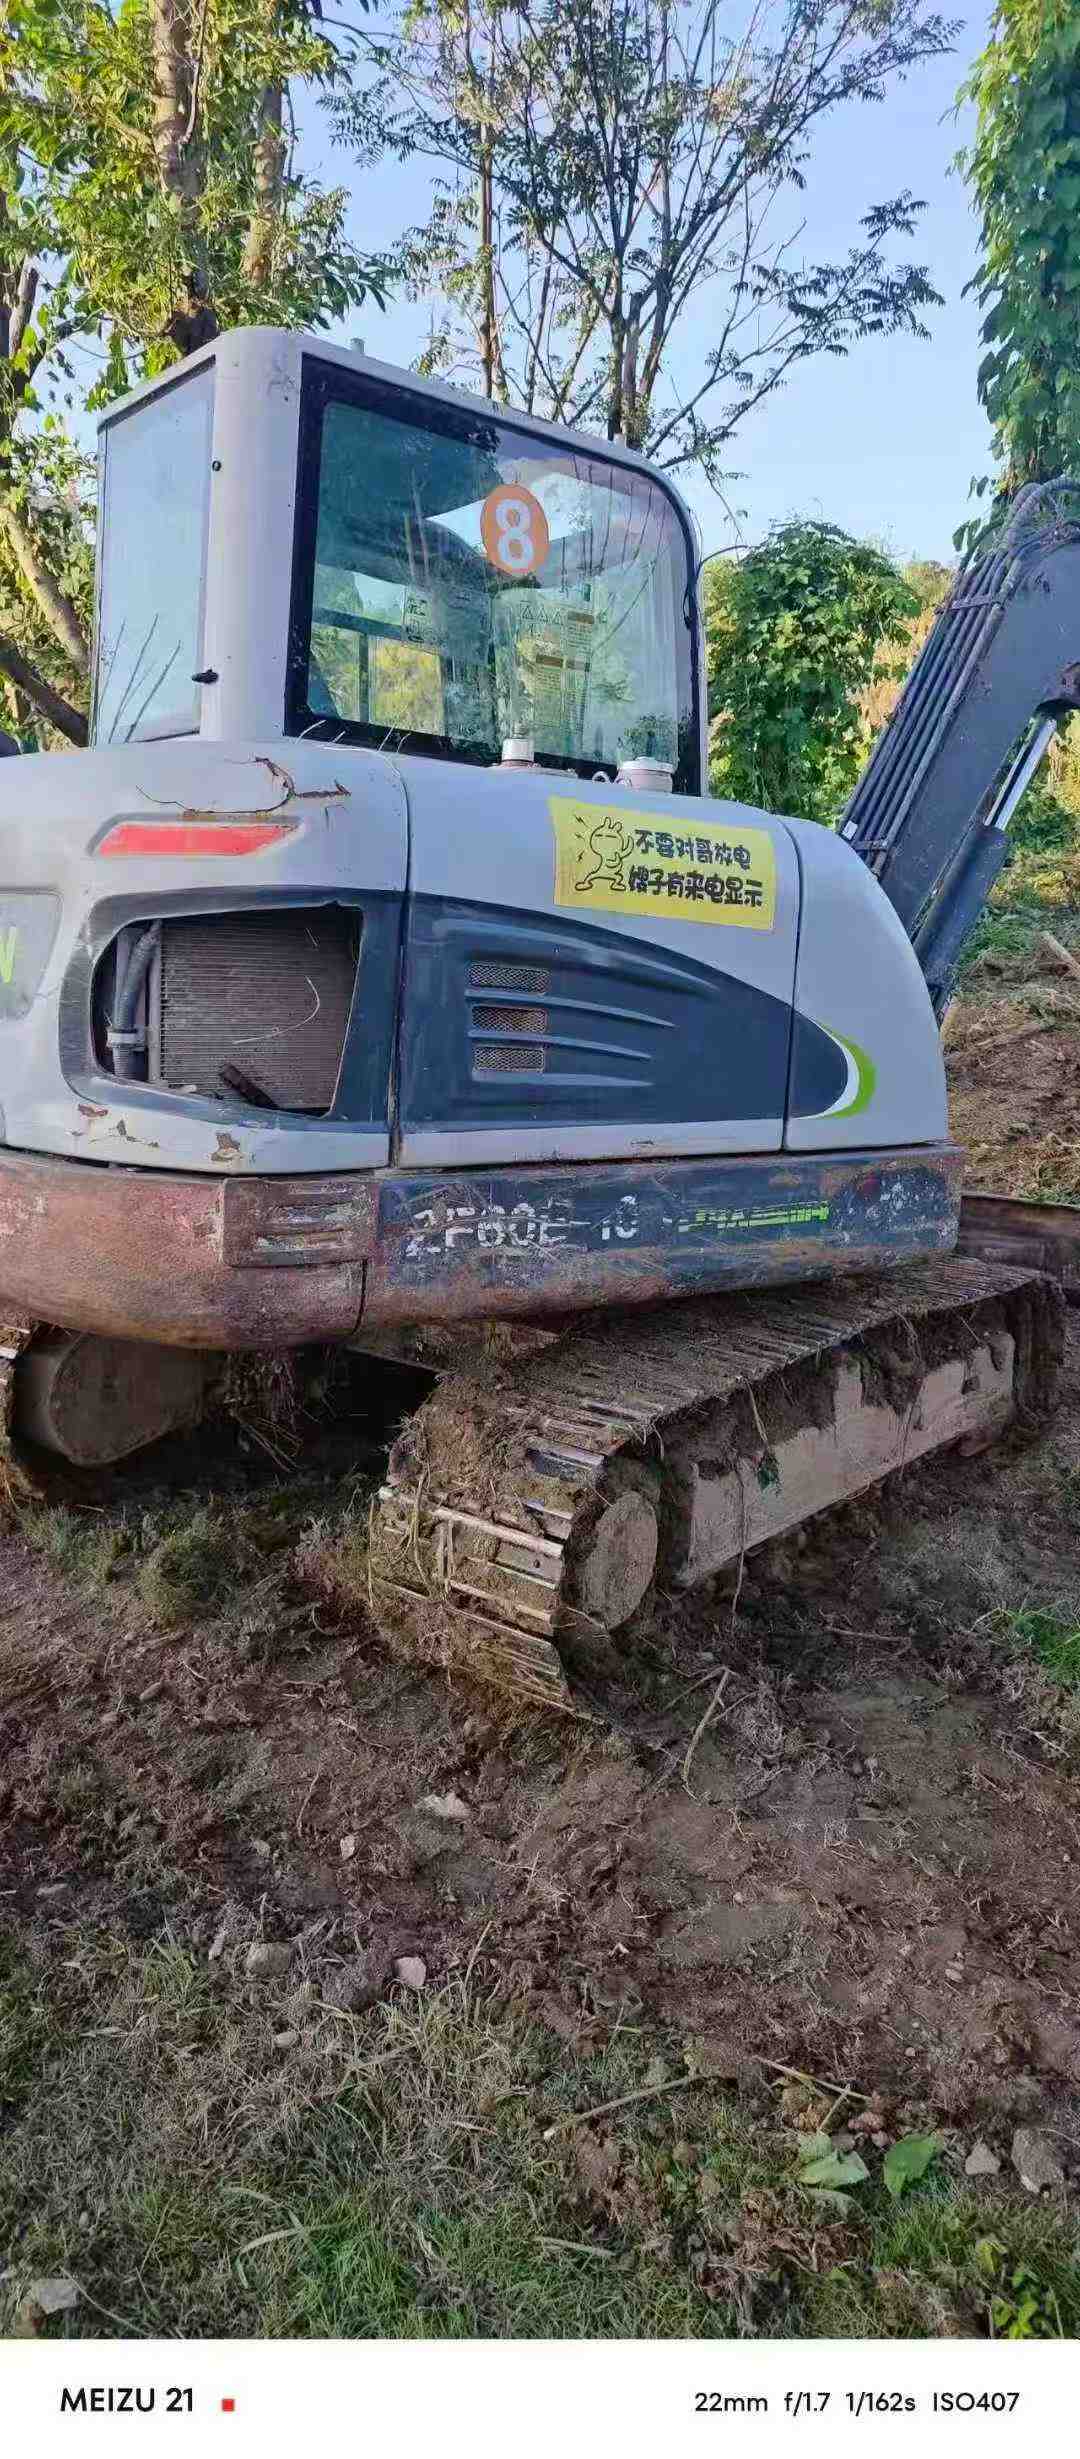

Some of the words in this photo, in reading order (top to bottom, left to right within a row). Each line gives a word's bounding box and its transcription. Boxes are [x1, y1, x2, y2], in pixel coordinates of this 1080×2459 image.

[494, 498, 534, 570] 8
[634, 828, 752, 871] 不要对哥放电
